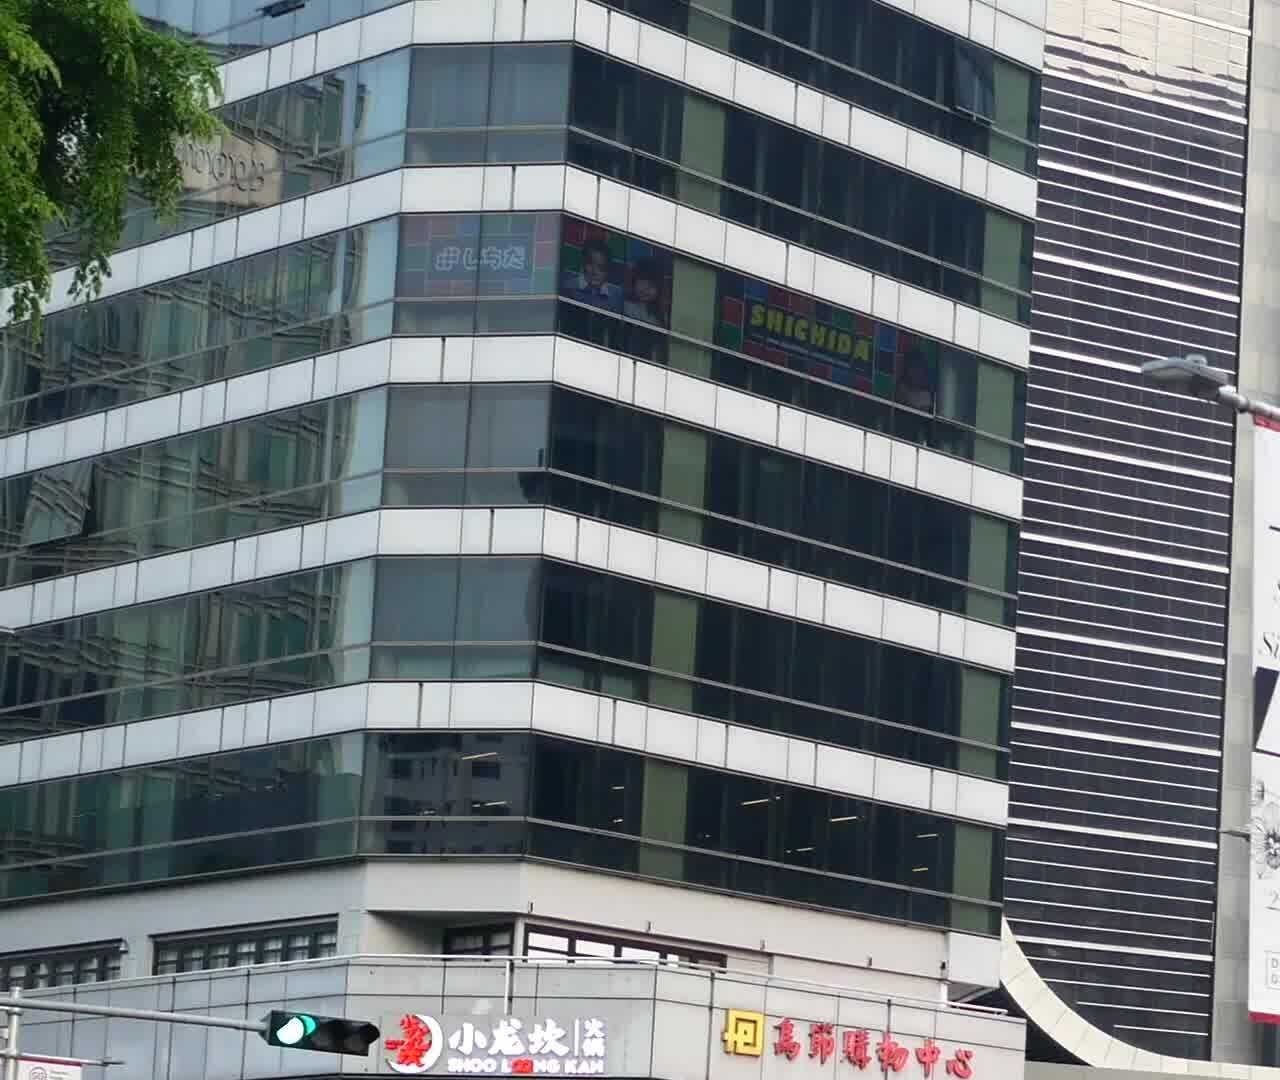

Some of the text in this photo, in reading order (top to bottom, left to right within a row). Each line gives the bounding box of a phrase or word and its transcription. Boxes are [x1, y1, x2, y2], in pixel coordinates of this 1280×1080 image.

[751, 303, 873, 361] SHICHIDA
[448, 1017, 571, 1056] 小龙坎
[565, 1058, 604, 1074] KAN
